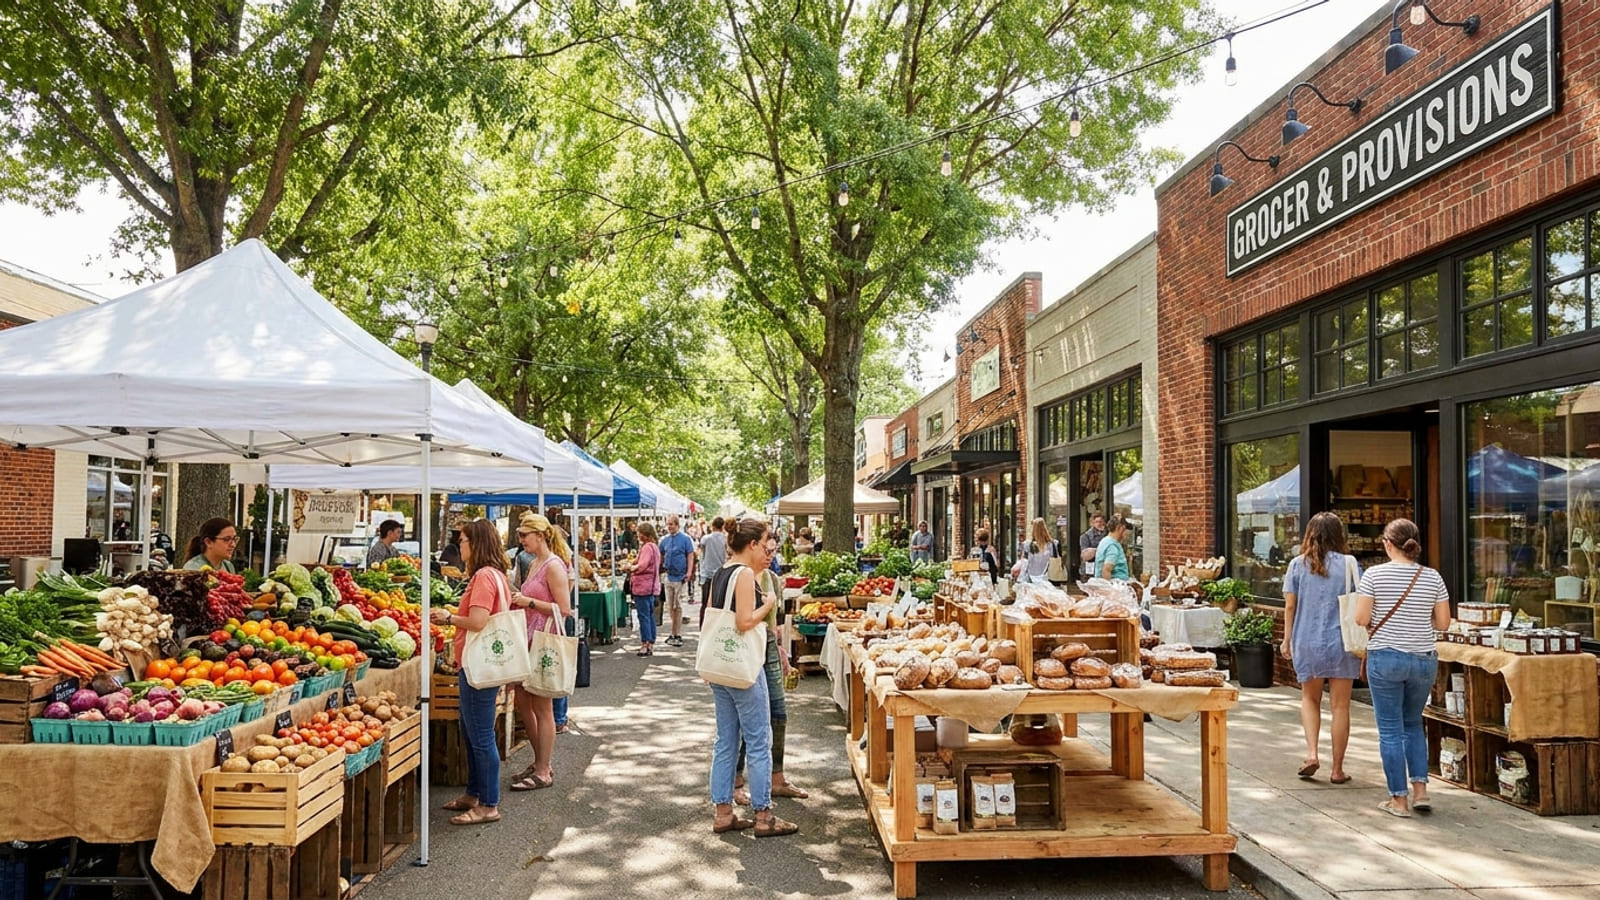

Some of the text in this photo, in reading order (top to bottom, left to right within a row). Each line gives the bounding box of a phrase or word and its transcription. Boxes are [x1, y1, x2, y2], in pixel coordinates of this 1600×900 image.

[1233, 43, 1534, 260] GROCER & PROVISIONS
